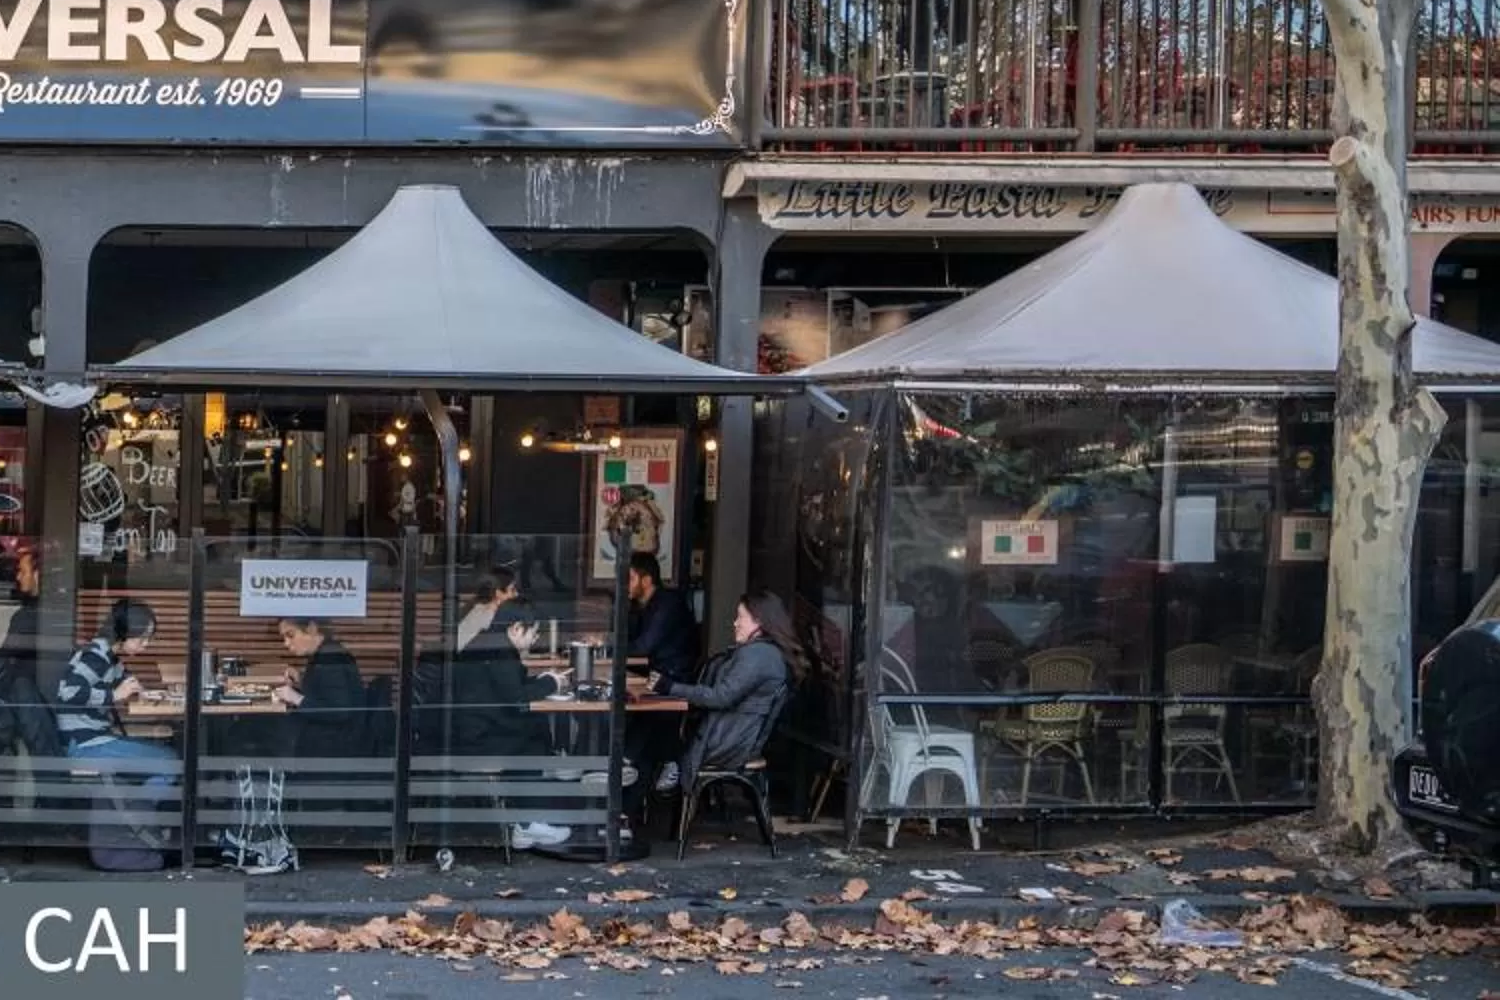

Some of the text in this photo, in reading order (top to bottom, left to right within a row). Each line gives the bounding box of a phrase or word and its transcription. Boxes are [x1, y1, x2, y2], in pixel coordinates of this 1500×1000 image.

[156, 80, 205, 106] est.
[213, 77, 284, 108] 1969
[775, 180, 915, 219] Little
[926, 181, 1064, 220] Pasta
[1410, 205, 1456, 223] AIRS
[121, 446, 178, 489] BEER
